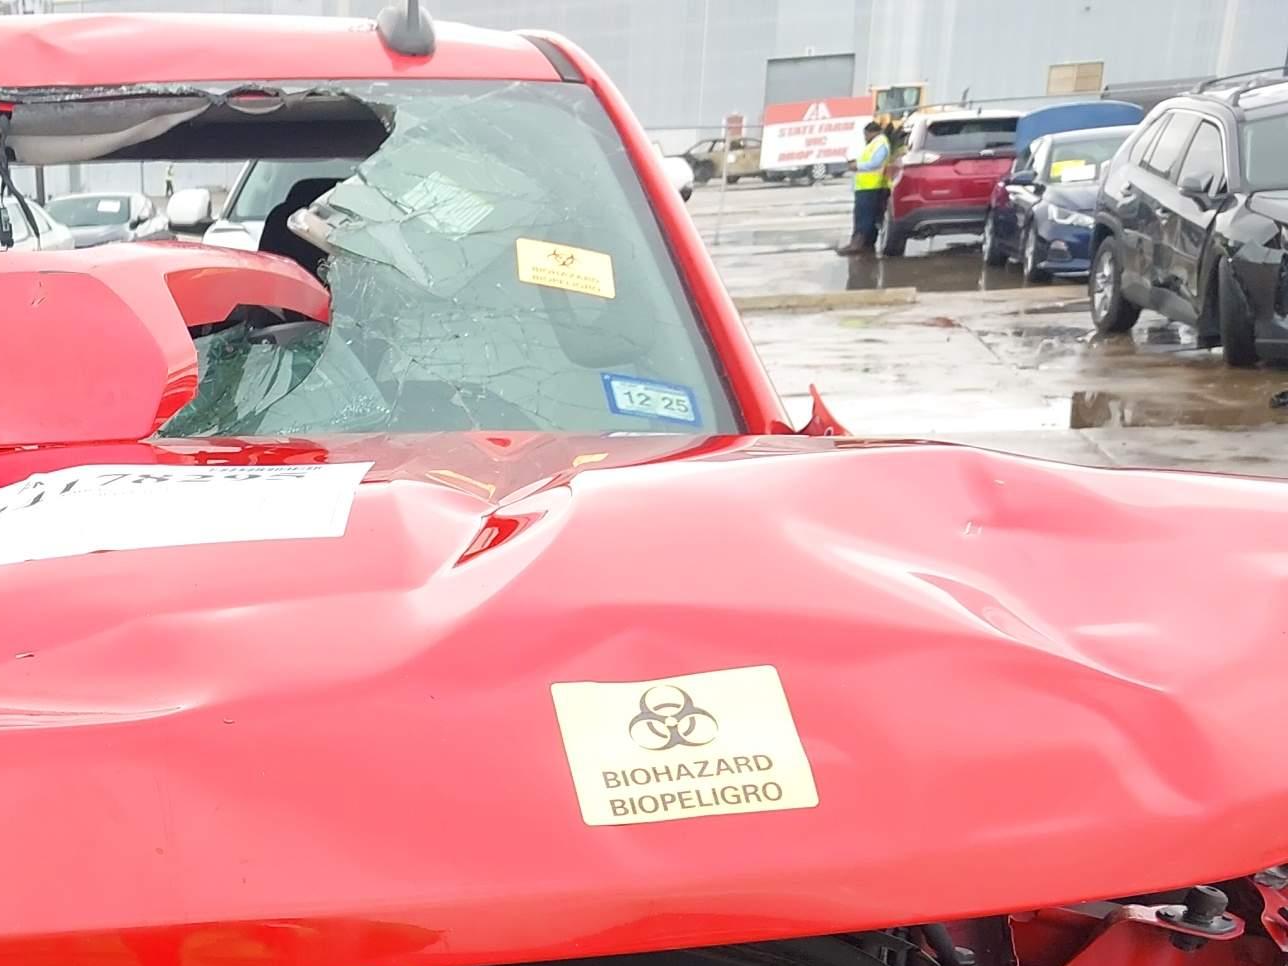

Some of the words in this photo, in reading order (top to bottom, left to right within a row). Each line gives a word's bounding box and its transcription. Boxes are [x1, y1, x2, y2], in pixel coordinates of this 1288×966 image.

[623, 391, 651, 407] 12
[661, 396, 689, 413] 25
[602, 754, 774, 790] BIOHAZARD
[609, 781, 782, 817] BIOPELIGRO
